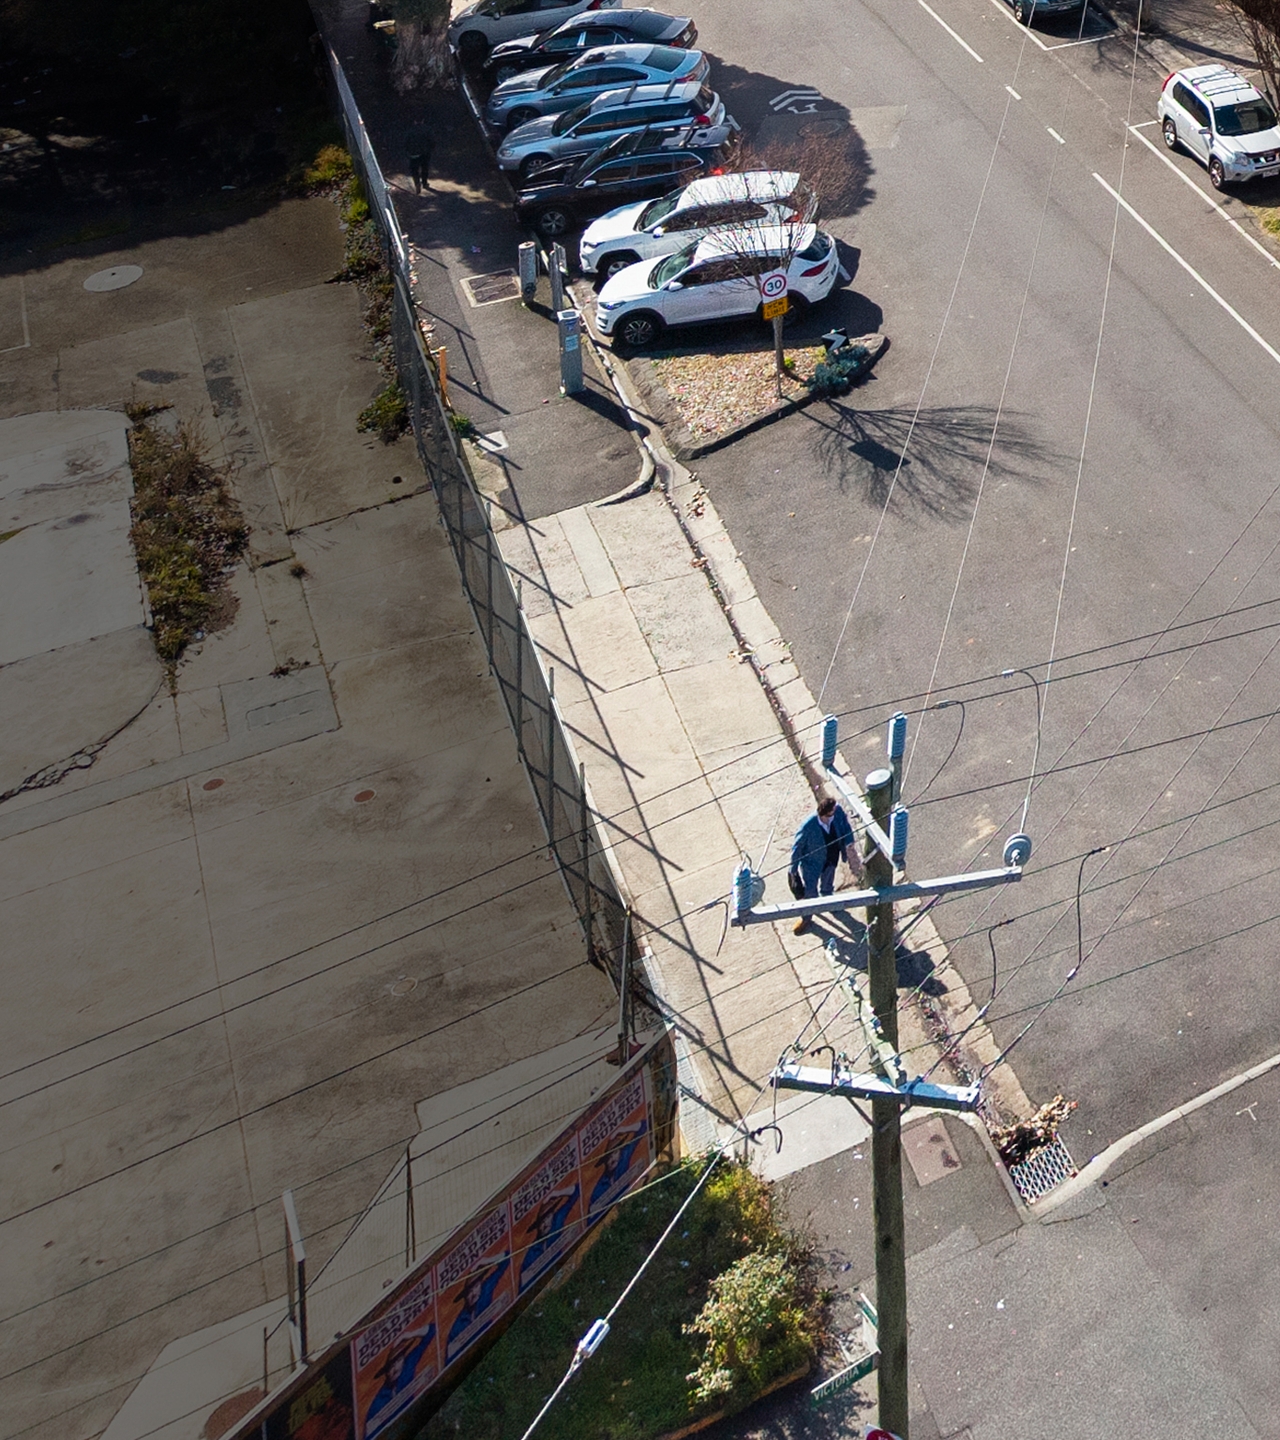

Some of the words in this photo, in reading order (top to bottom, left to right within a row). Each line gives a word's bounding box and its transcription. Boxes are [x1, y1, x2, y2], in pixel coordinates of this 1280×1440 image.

[767, 279, 782, 292] 30
[582, 1111, 615, 1147] DEAD
[619, 1085, 641, 1111] SET
[583, 1094, 642, 1156] COUNTRY
[514, 1175, 549, 1212] DEAD
[552, 1148, 576, 1175] SET
[514, 1157, 576, 1221] COUNTRY
[439, 1238, 477, 1282] DEAD
[480, 1213, 506, 1239] SET
[440, 1224, 506, 1289] COUNTRY
[358, 1315, 401, 1357] DEAD
[359, 1300, 430, 1367] COUNTRY
[813, 1366, 859, 1401] VICTORIA
